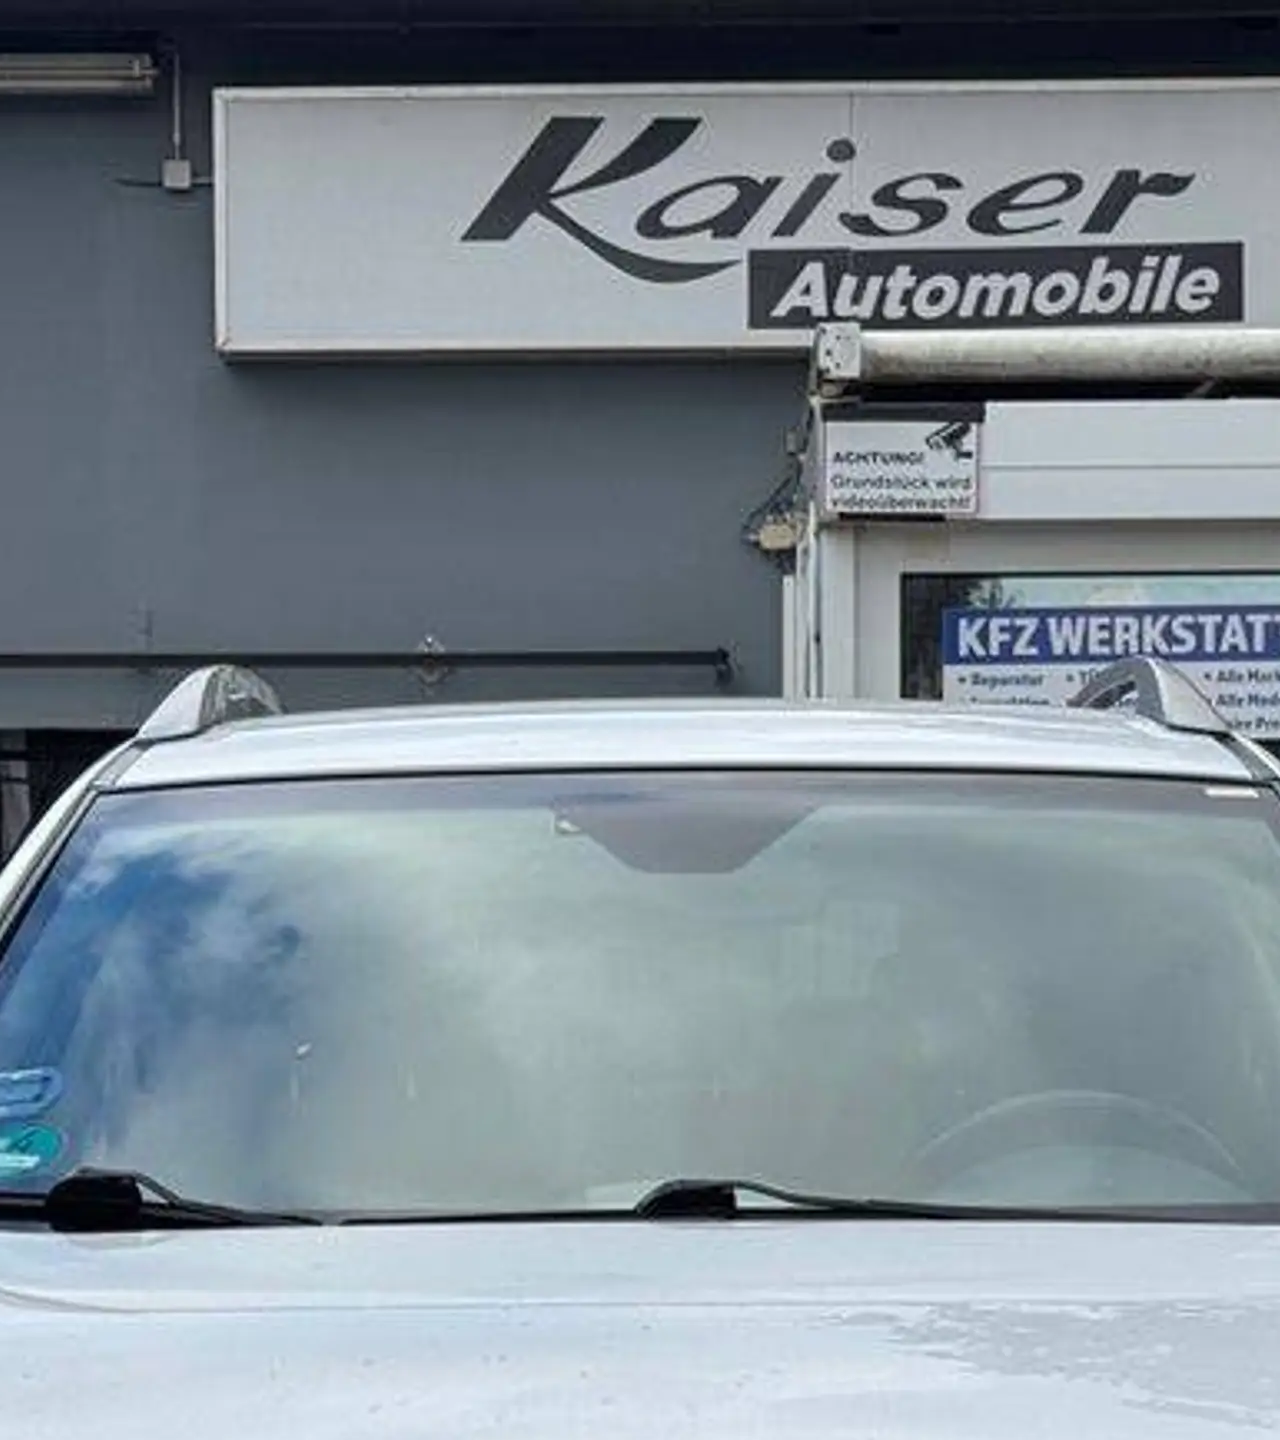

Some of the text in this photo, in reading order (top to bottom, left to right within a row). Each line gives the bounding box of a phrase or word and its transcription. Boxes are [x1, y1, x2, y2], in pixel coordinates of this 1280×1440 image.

[461, 117, 1195, 283] Kaiser
[772, 257, 1221, 320] Automobile
[833, 451, 924, 465] ACHTUNG!
[934, 475, 971, 490] wird
[957, 616, 1039, 656] KFZ
